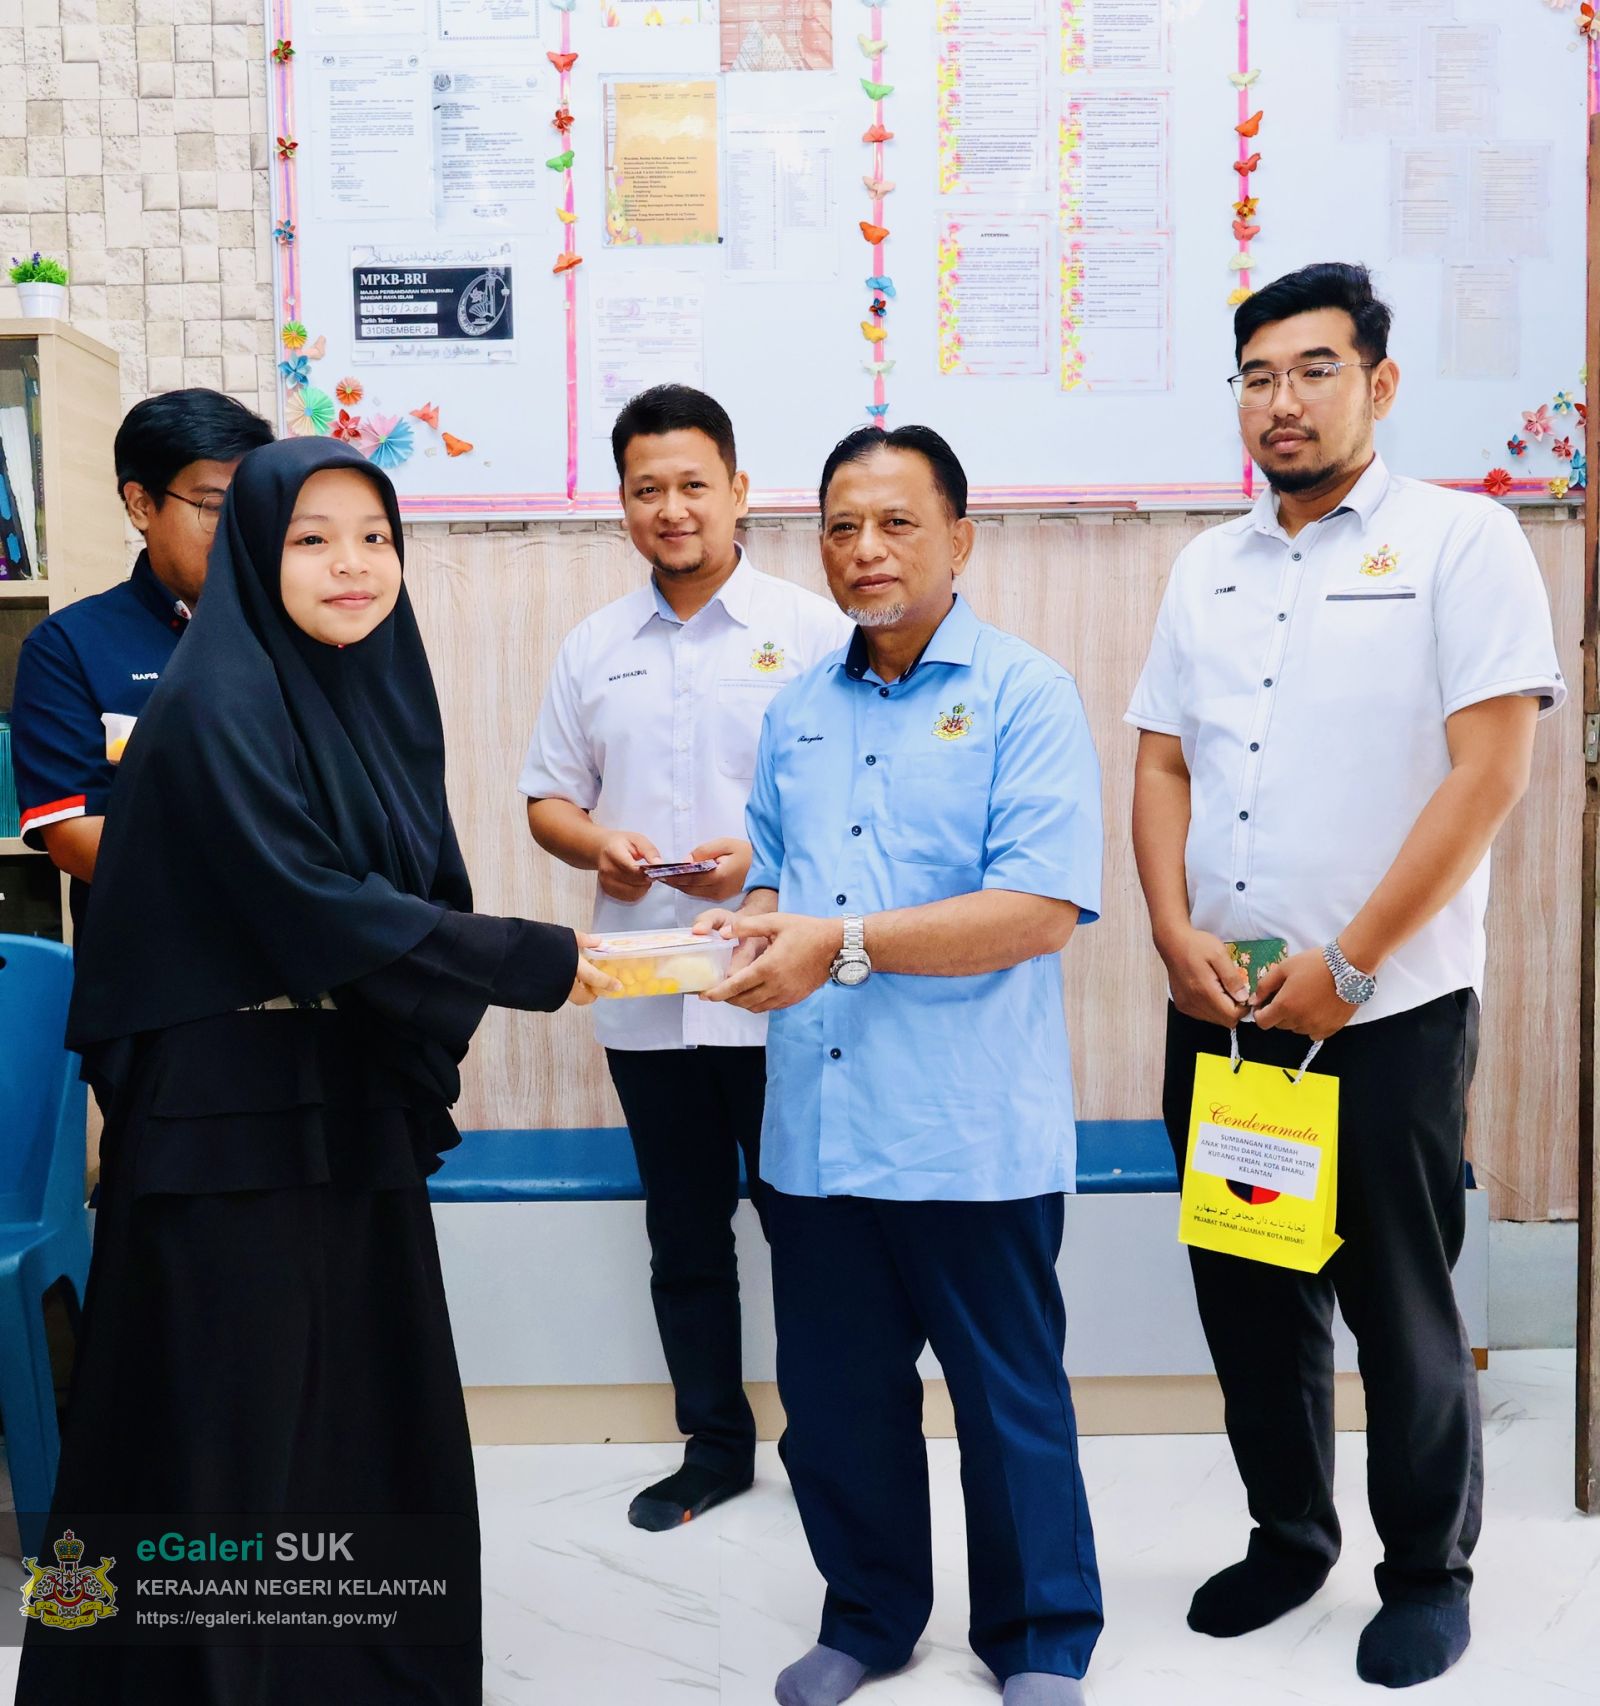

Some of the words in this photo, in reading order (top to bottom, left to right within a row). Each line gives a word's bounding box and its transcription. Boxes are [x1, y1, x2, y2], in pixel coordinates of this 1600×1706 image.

[360, 273, 427, 285] MPKB-BRI
[1209, 1102, 1320, 1142] Cenderamata
[1201, 1139, 1218, 1147] ANAK
[1221, 1144, 1240, 1153] YATIM
[1241, 1148, 1262, 1157] DARUL
[1264, 1153, 1294, 1164] KAUTSAR
[1221, 1134, 1263, 1148] SUMBANGAN
[1274, 1146, 1298, 1155] RUMAH
[1208, 1151, 1235, 1161] KUBANG
[1264, 1162, 1280, 1170] KOTA
[1238, 1166, 1273, 1178] KELANTAN
[1194, 1216, 1218, 1226] PEJABAT
[1219, 1221, 1238, 1231] TANAH
[1239, 1225, 1265, 1236] JAJAHAN
[1267, 1231, 1283, 1241] KOTA
[1284, 1235, 1305, 1245] BHARU
